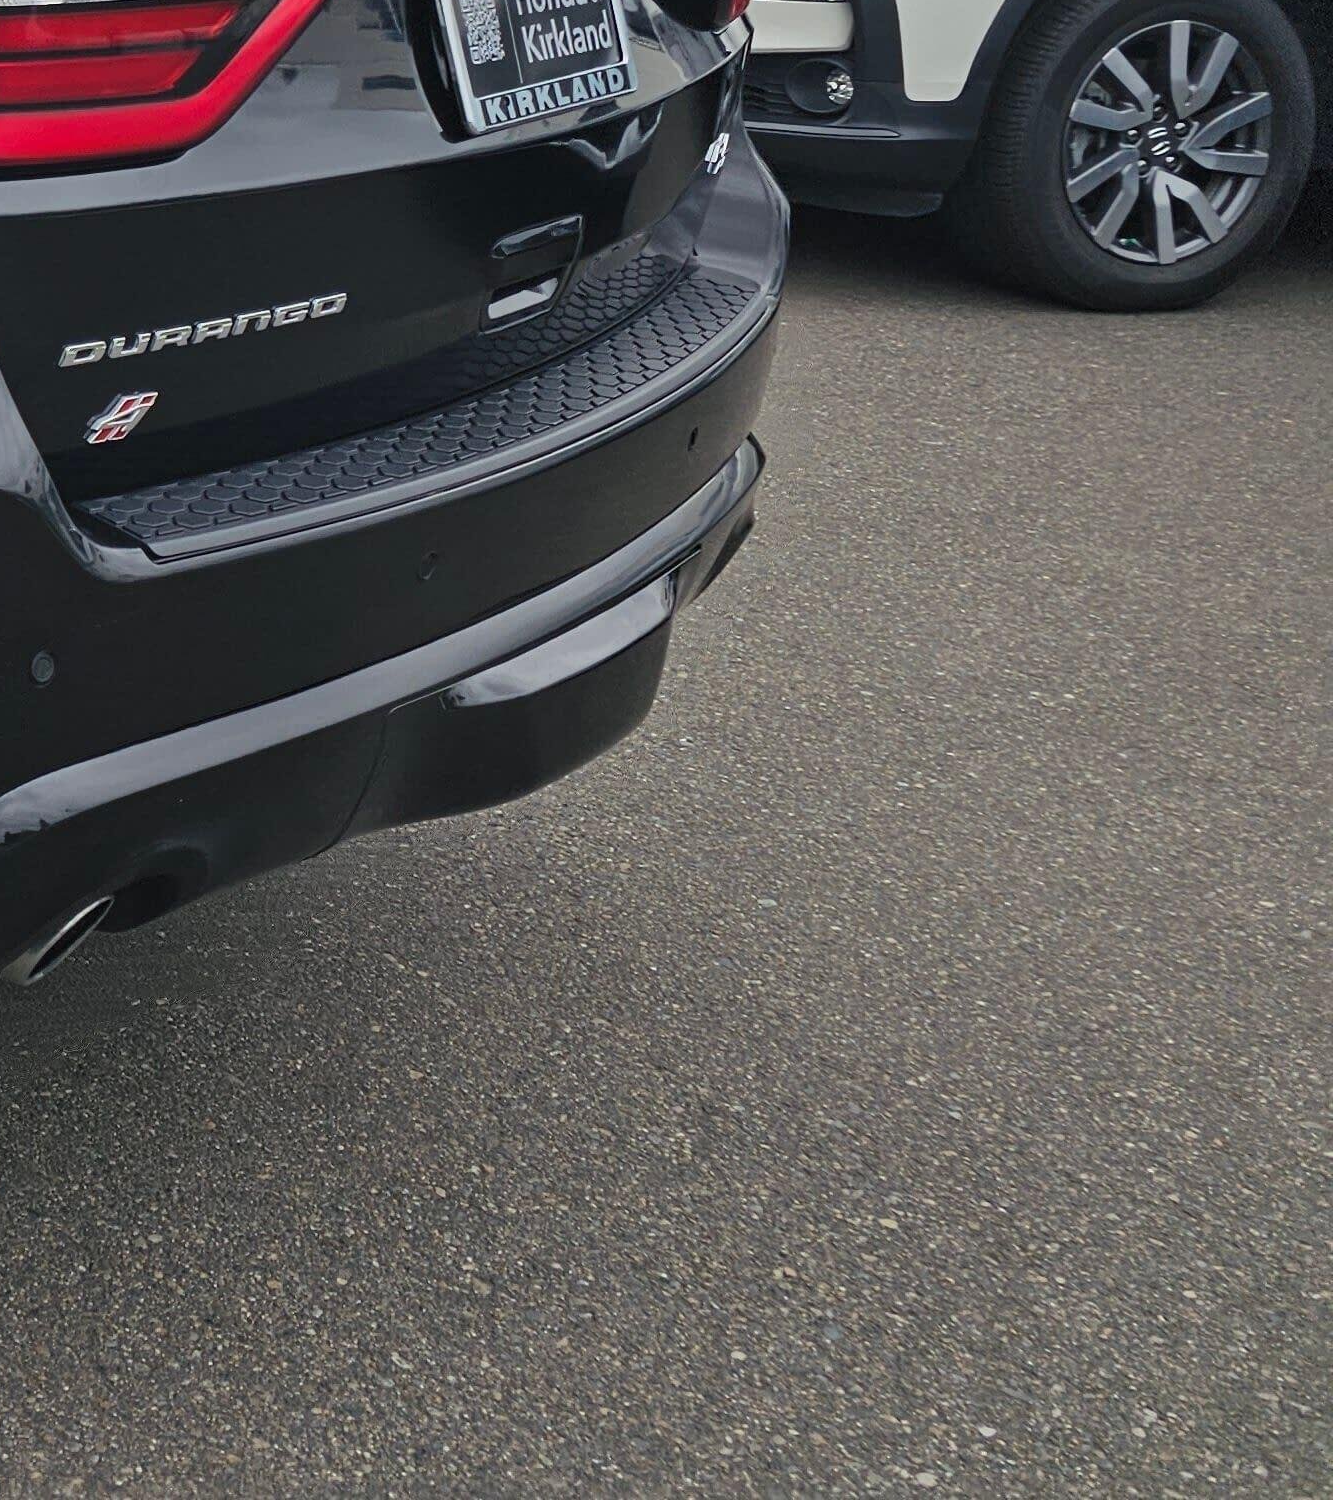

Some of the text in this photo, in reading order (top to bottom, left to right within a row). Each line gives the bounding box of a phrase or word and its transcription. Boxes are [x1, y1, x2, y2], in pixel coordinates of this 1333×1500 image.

[520, 9, 614, 65] Kirkland
[484, 66, 625, 126] KIRKLAND
[58, 292, 348, 368] DURANGO
